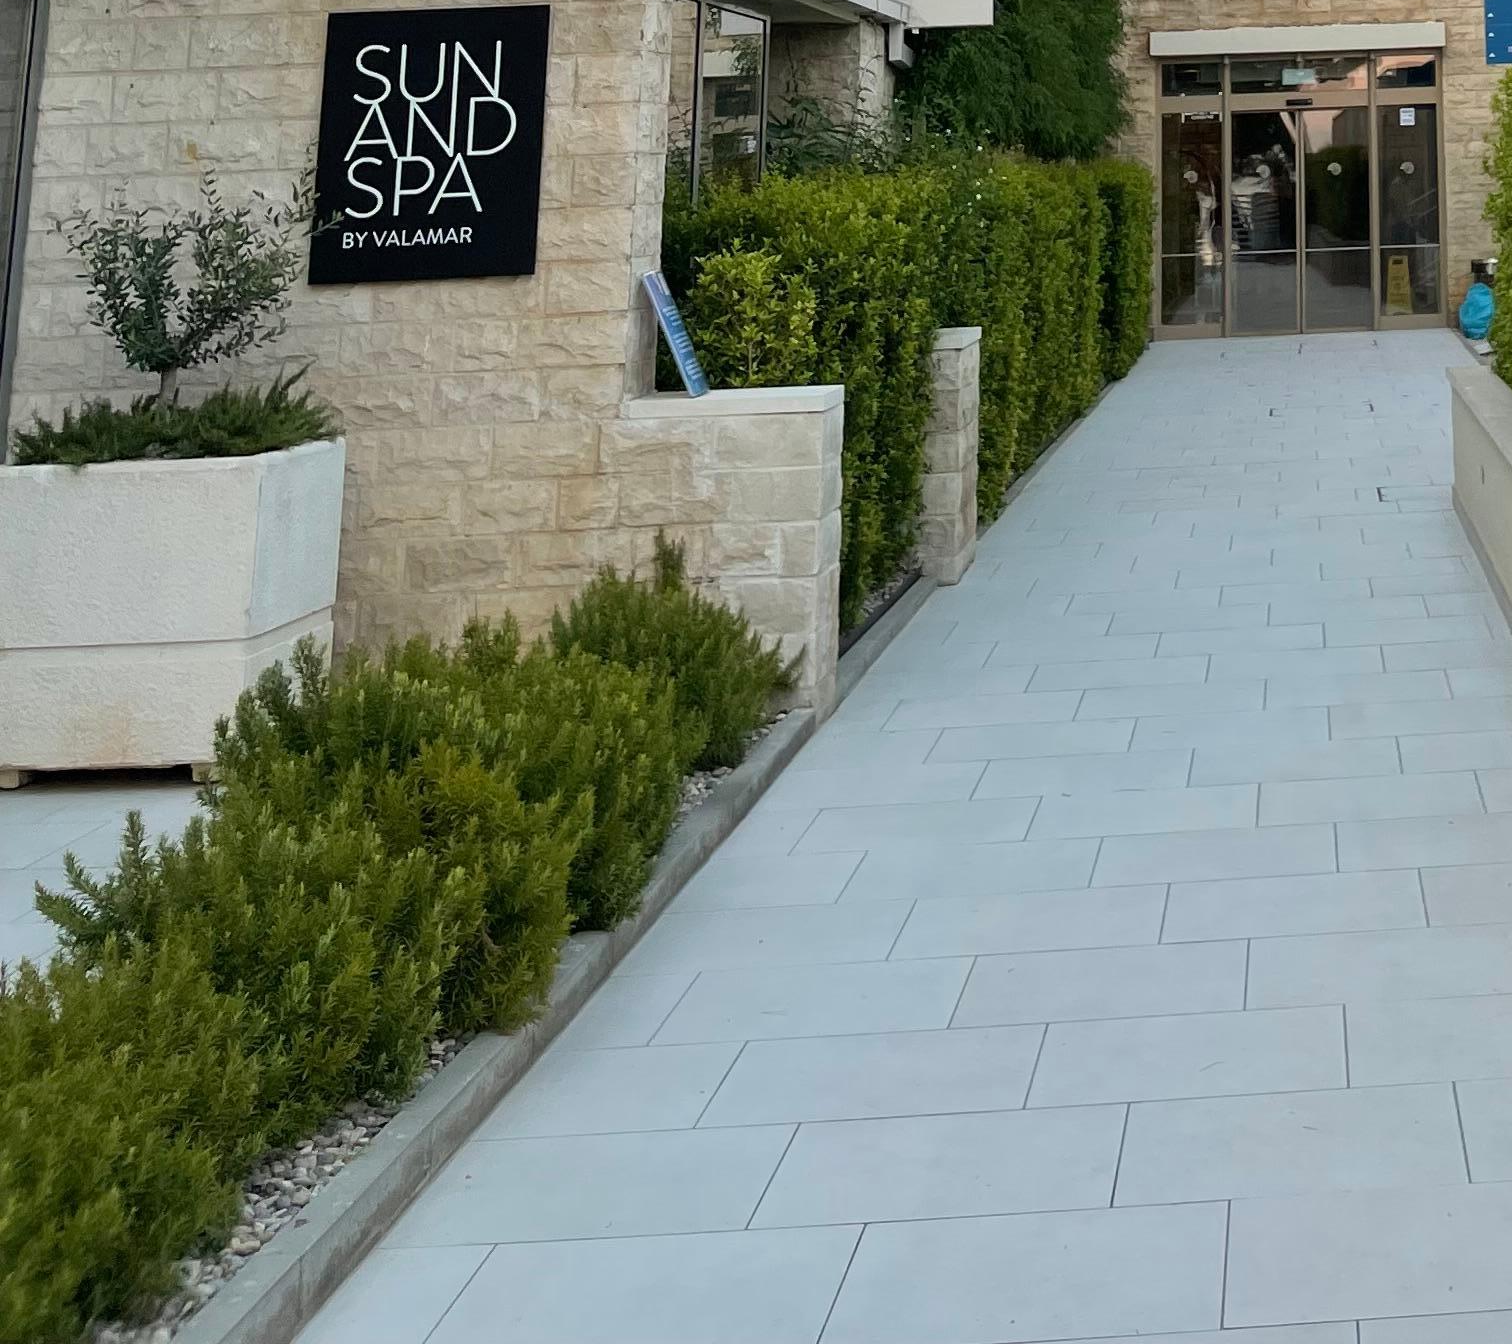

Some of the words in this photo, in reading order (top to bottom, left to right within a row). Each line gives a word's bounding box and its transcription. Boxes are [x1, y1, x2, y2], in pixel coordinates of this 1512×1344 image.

[353, 40, 502, 105] SUN
[344, 96, 517, 161] AND
[345, 153, 482, 218] SPA
[342, 231, 368, 249] BY
[372, 226, 472, 247] VALAMAR
